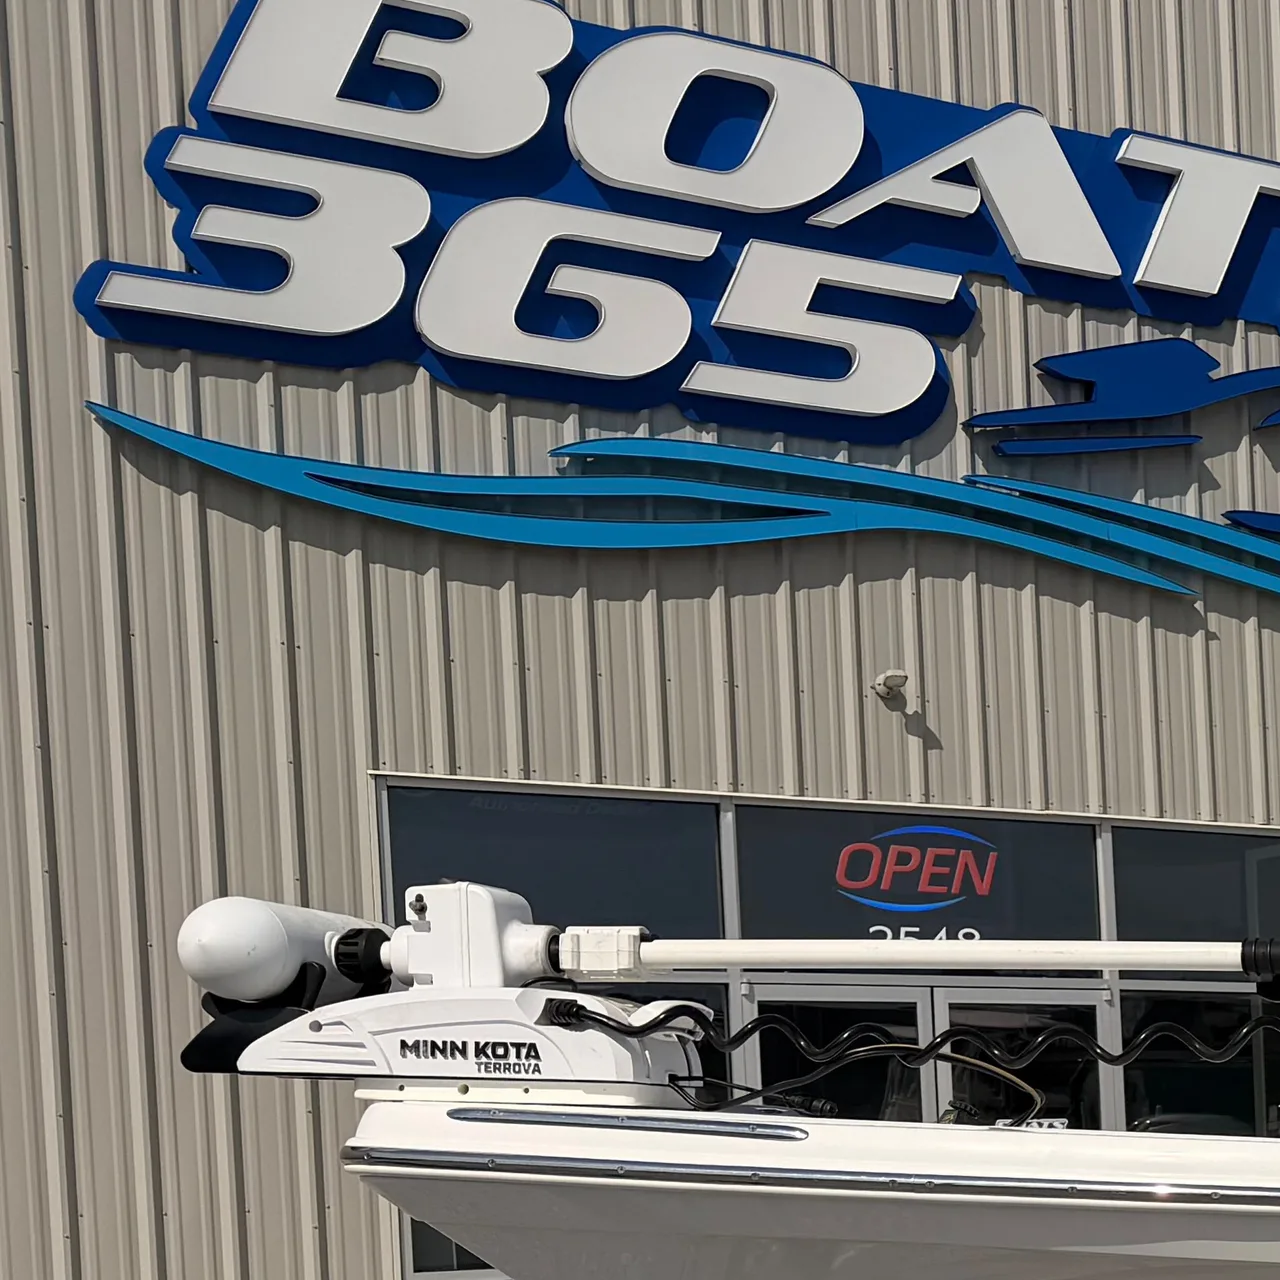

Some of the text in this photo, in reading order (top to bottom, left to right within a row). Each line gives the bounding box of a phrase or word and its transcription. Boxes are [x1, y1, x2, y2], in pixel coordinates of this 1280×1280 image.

[95, 134, 961, 417] 365
[835, 842, 998, 896] OPEN
[400, 1039, 542, 1062] MINN KOTA
[474, 1061, 542, 1075] TERROVA
